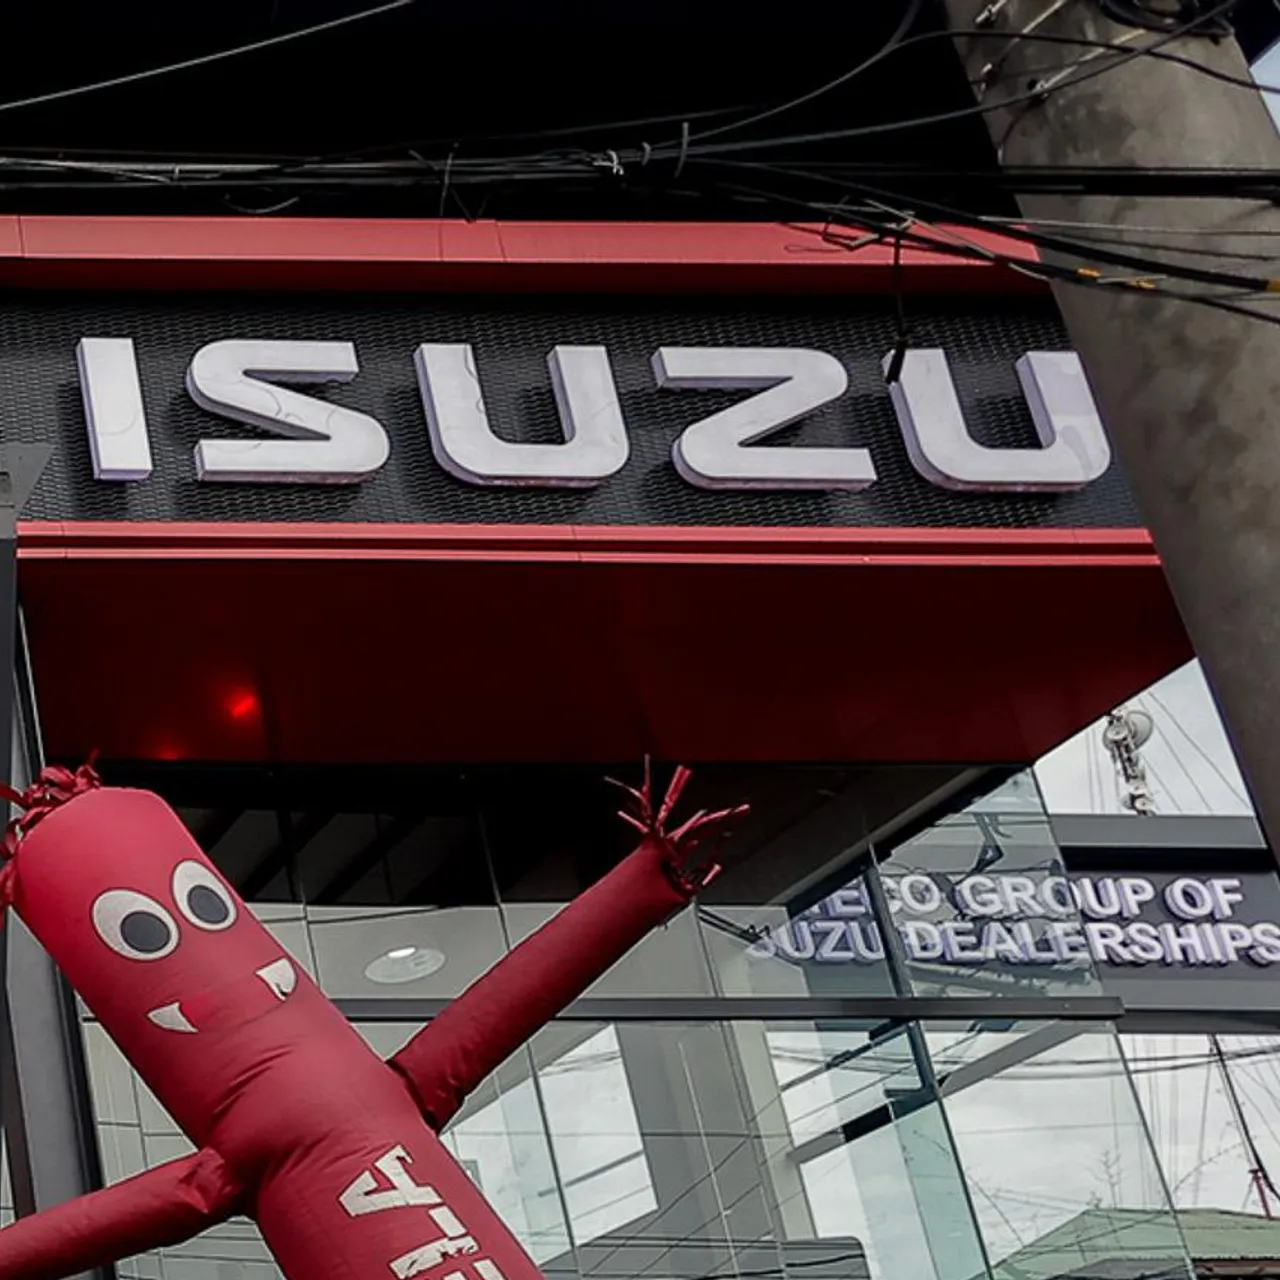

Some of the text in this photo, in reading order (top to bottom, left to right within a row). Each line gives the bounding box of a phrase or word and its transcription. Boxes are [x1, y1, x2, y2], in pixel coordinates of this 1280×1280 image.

[77, 336, 1111, 492] ISUZU
[953, 875, 1154, 919] GROUP
[1164, 877, 1244, 919] OF
[903, 922, 1280, 966] DEALERSHIPS
